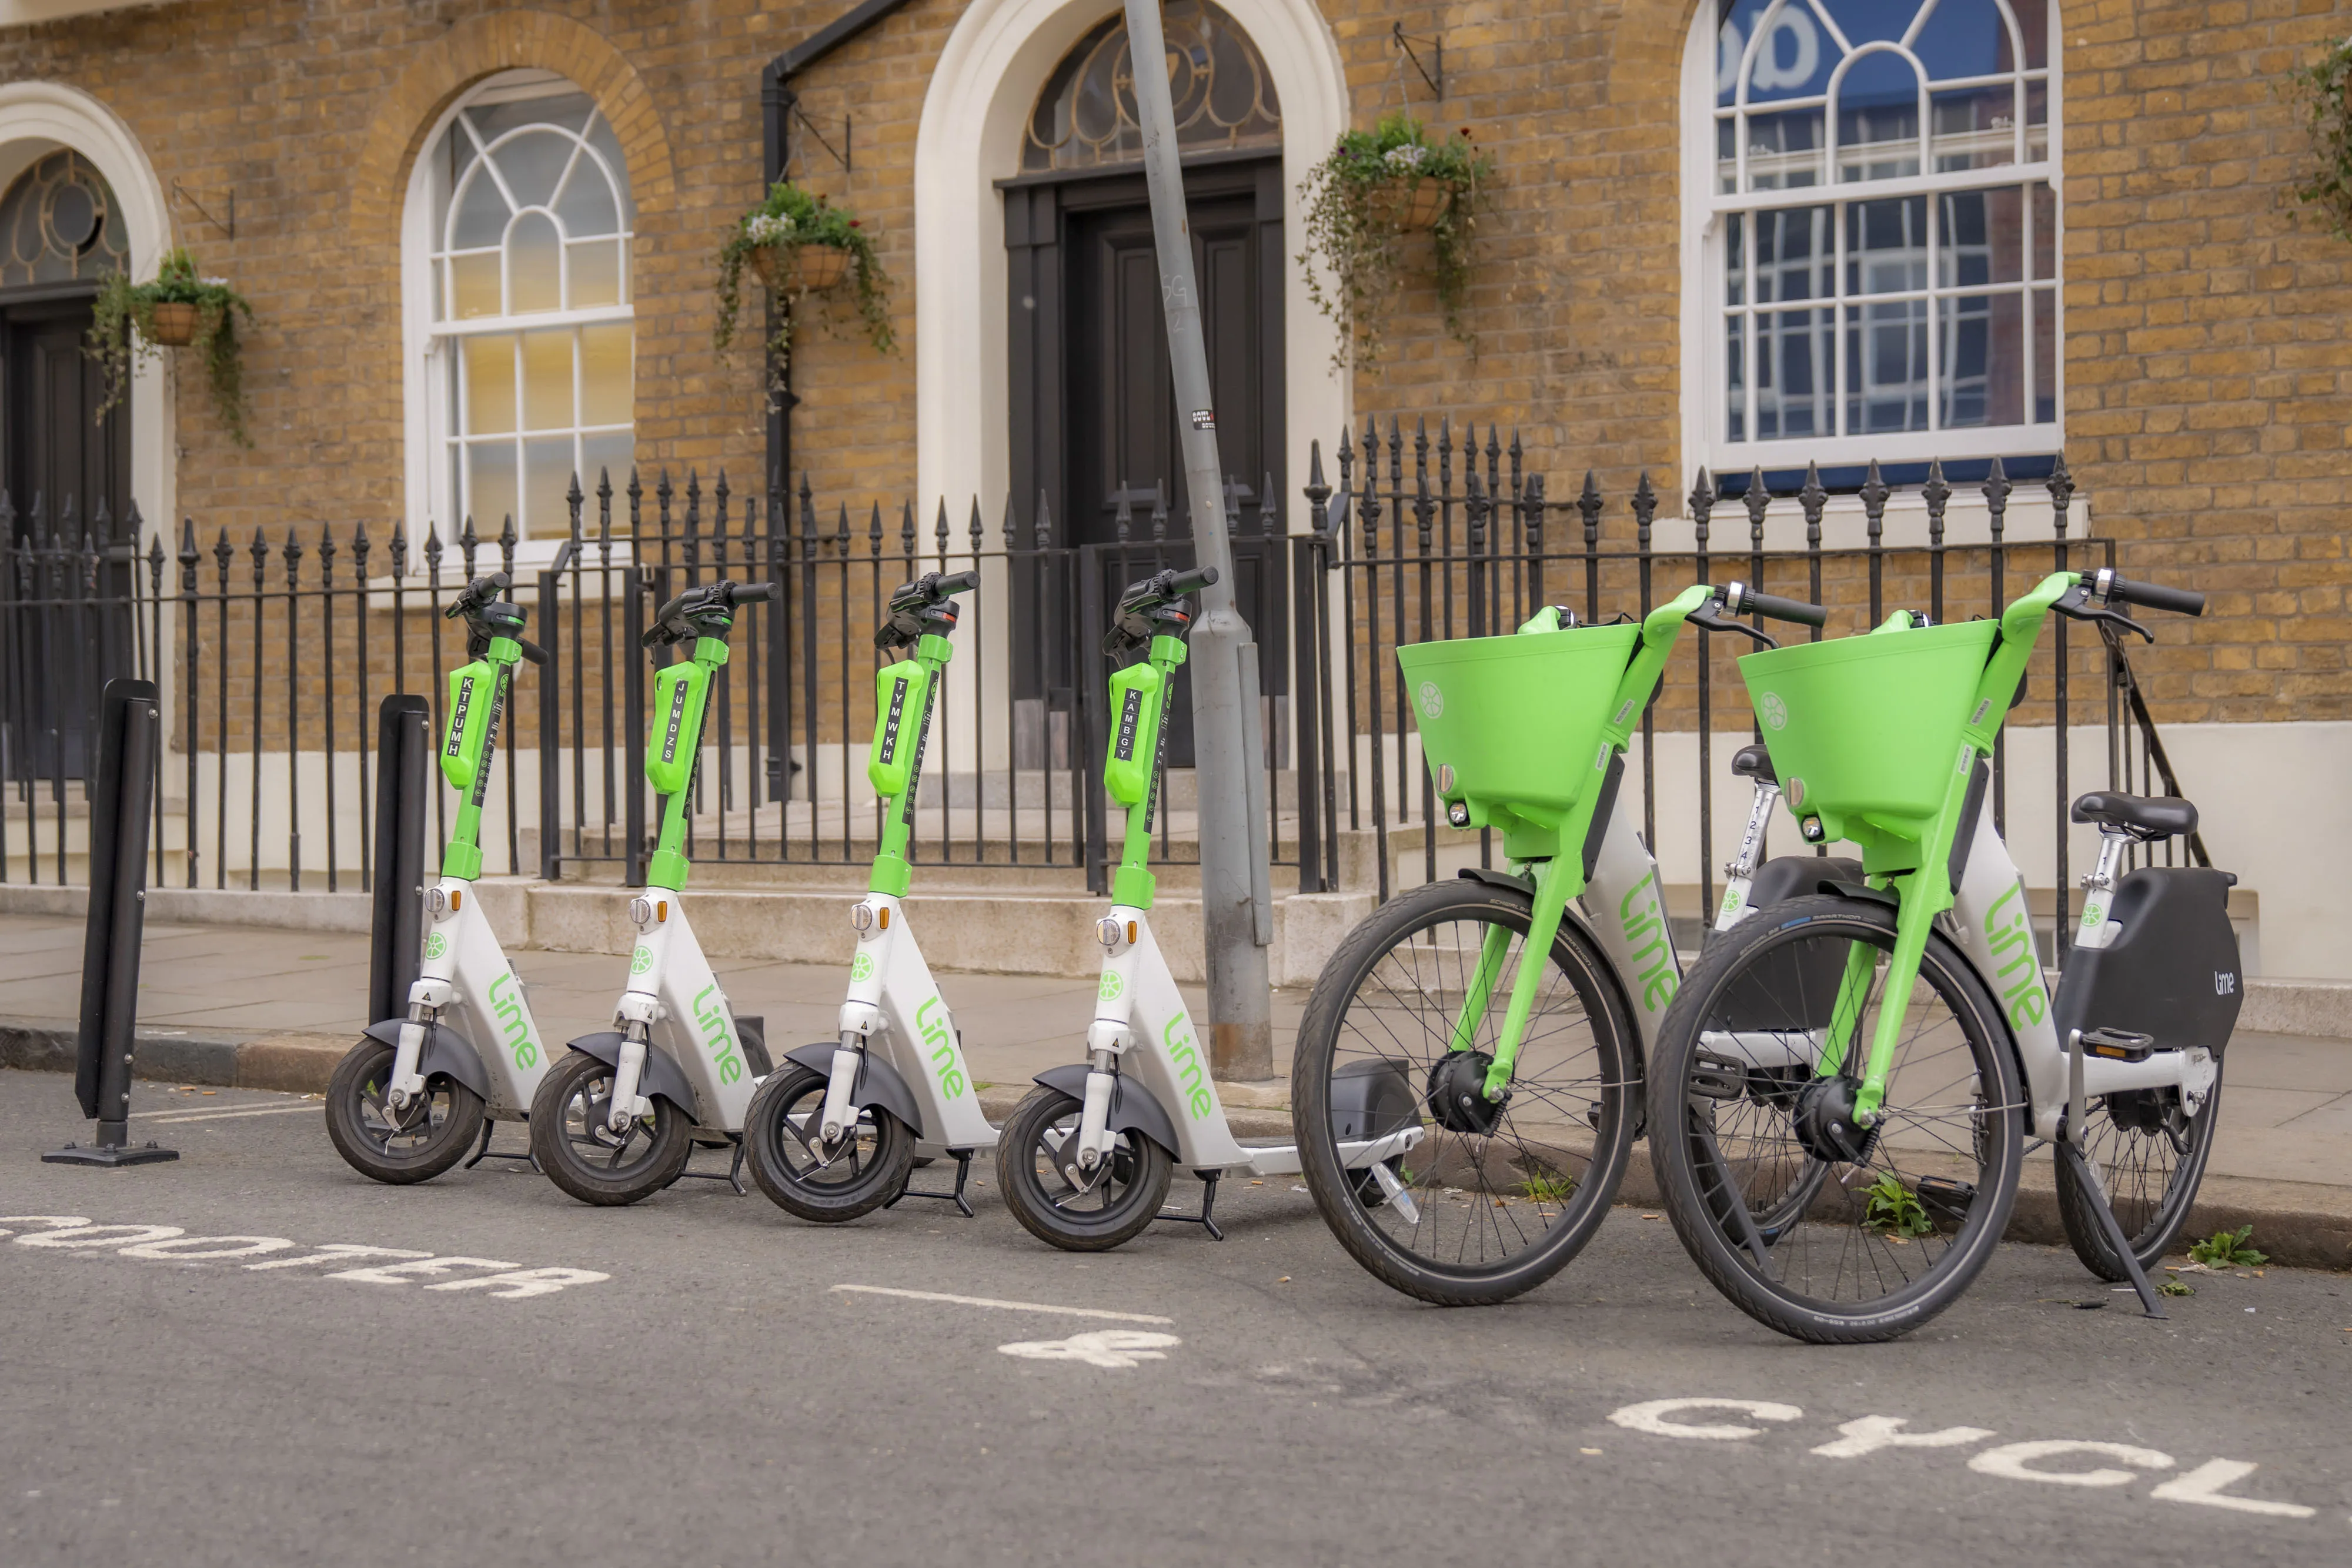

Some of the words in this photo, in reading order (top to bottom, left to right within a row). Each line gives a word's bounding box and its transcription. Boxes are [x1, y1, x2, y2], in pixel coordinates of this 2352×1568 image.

[448, 678, 473, 755] KTPUMH
[664, 683, 684, 759] JUMDZS
[883, 681, 905, 760] TYMWKH
[1120, 690, 1137, 758] KAMBGY
[1984, 881, 2045, 1032] Lime
[2214, 971, 2234, 995] Lime
[489, 972, 537, 1071] Lime
[693, 984, 741, 1085] Lime
[916, 995, 964, 1101] Lime
[1164, 1011, 1211, 1121] Lime
[1605, 1397, 2351, 1524] CYCL
